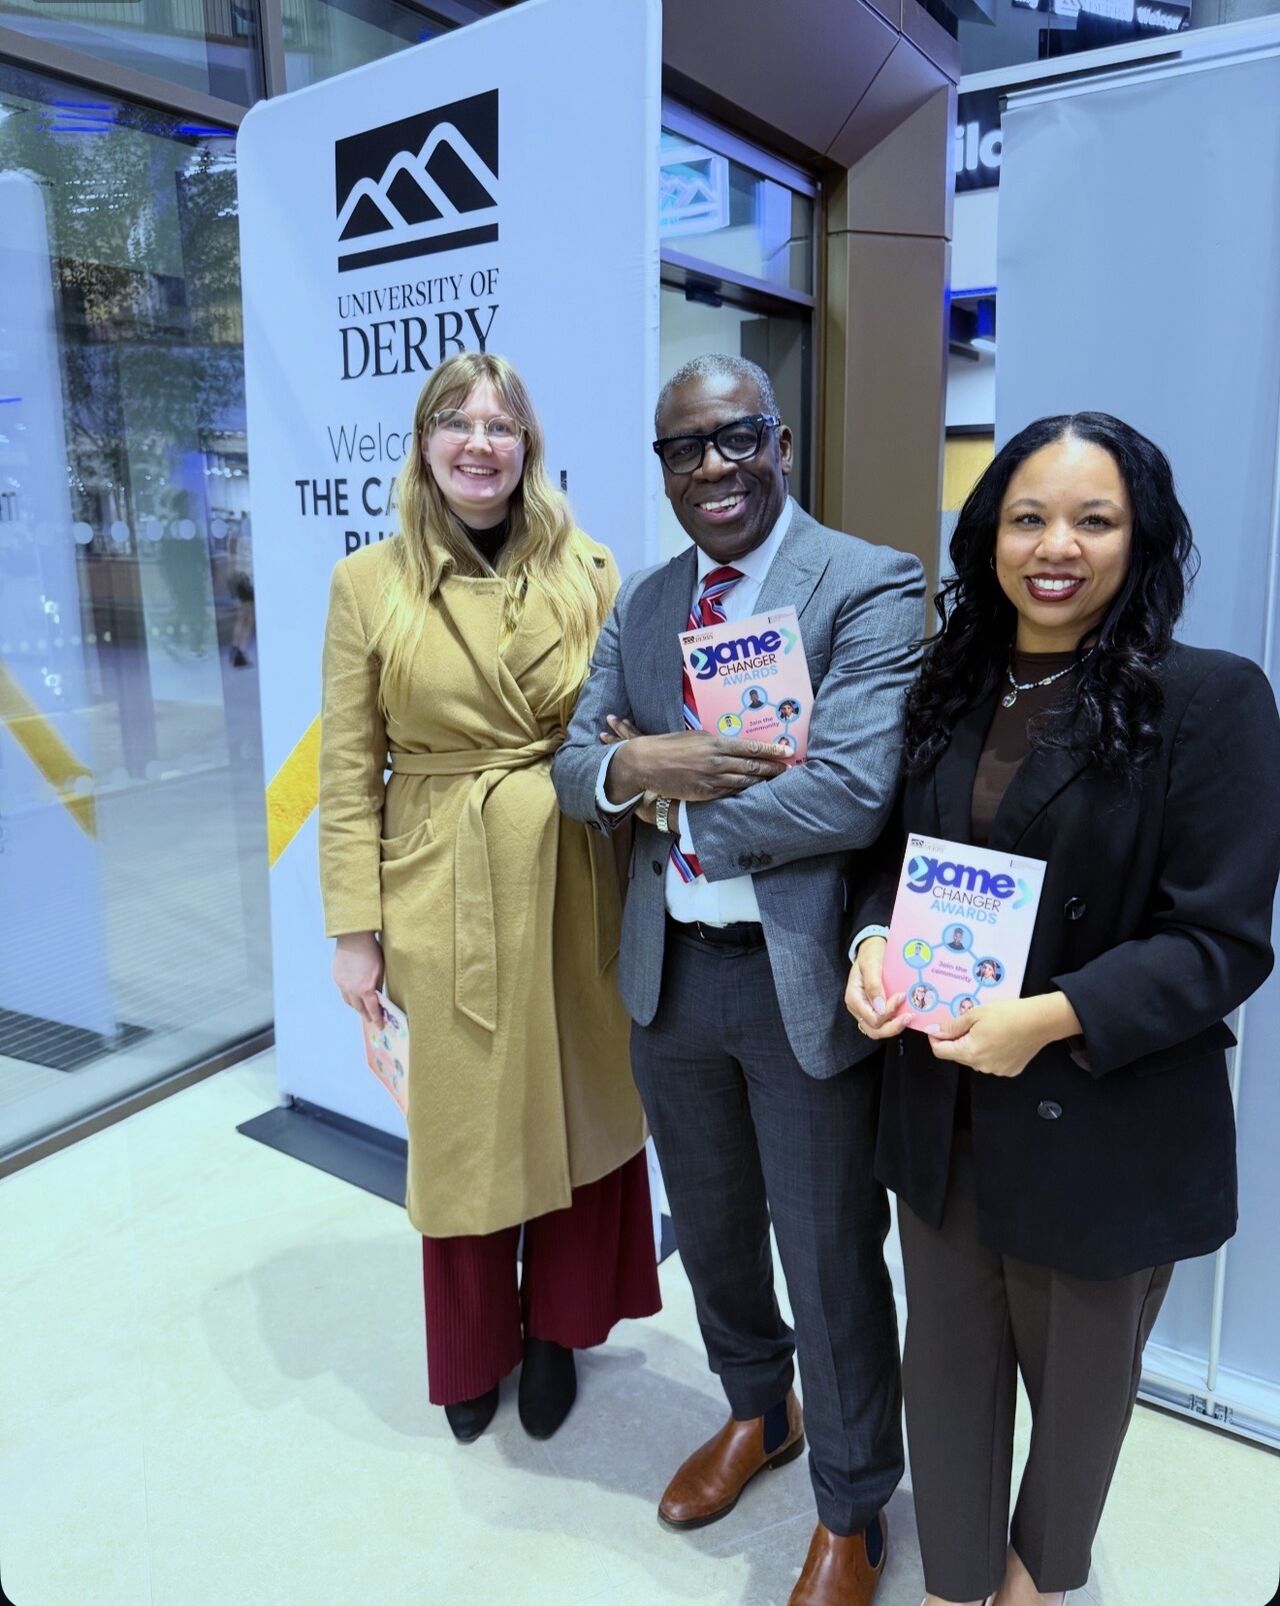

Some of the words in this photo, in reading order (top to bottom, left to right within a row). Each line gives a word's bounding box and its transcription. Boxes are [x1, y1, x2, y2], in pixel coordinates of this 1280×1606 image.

[338, 274, 463, 319] UNIVERSITY
[470, 268, 499, 297] OF
[339, 304, 499, 380] DERBY
[295, 479, 349, 516] THE
[690, 630, 782, 680] game
[718, 654, 777, 677] CHANGER
[723, 665, 778, 687] AWARDS
[906, 855, 1016, 899] game
[930, 899, 998, 925] AWARDS
[932, 885, 1001, 912] CHANGER
